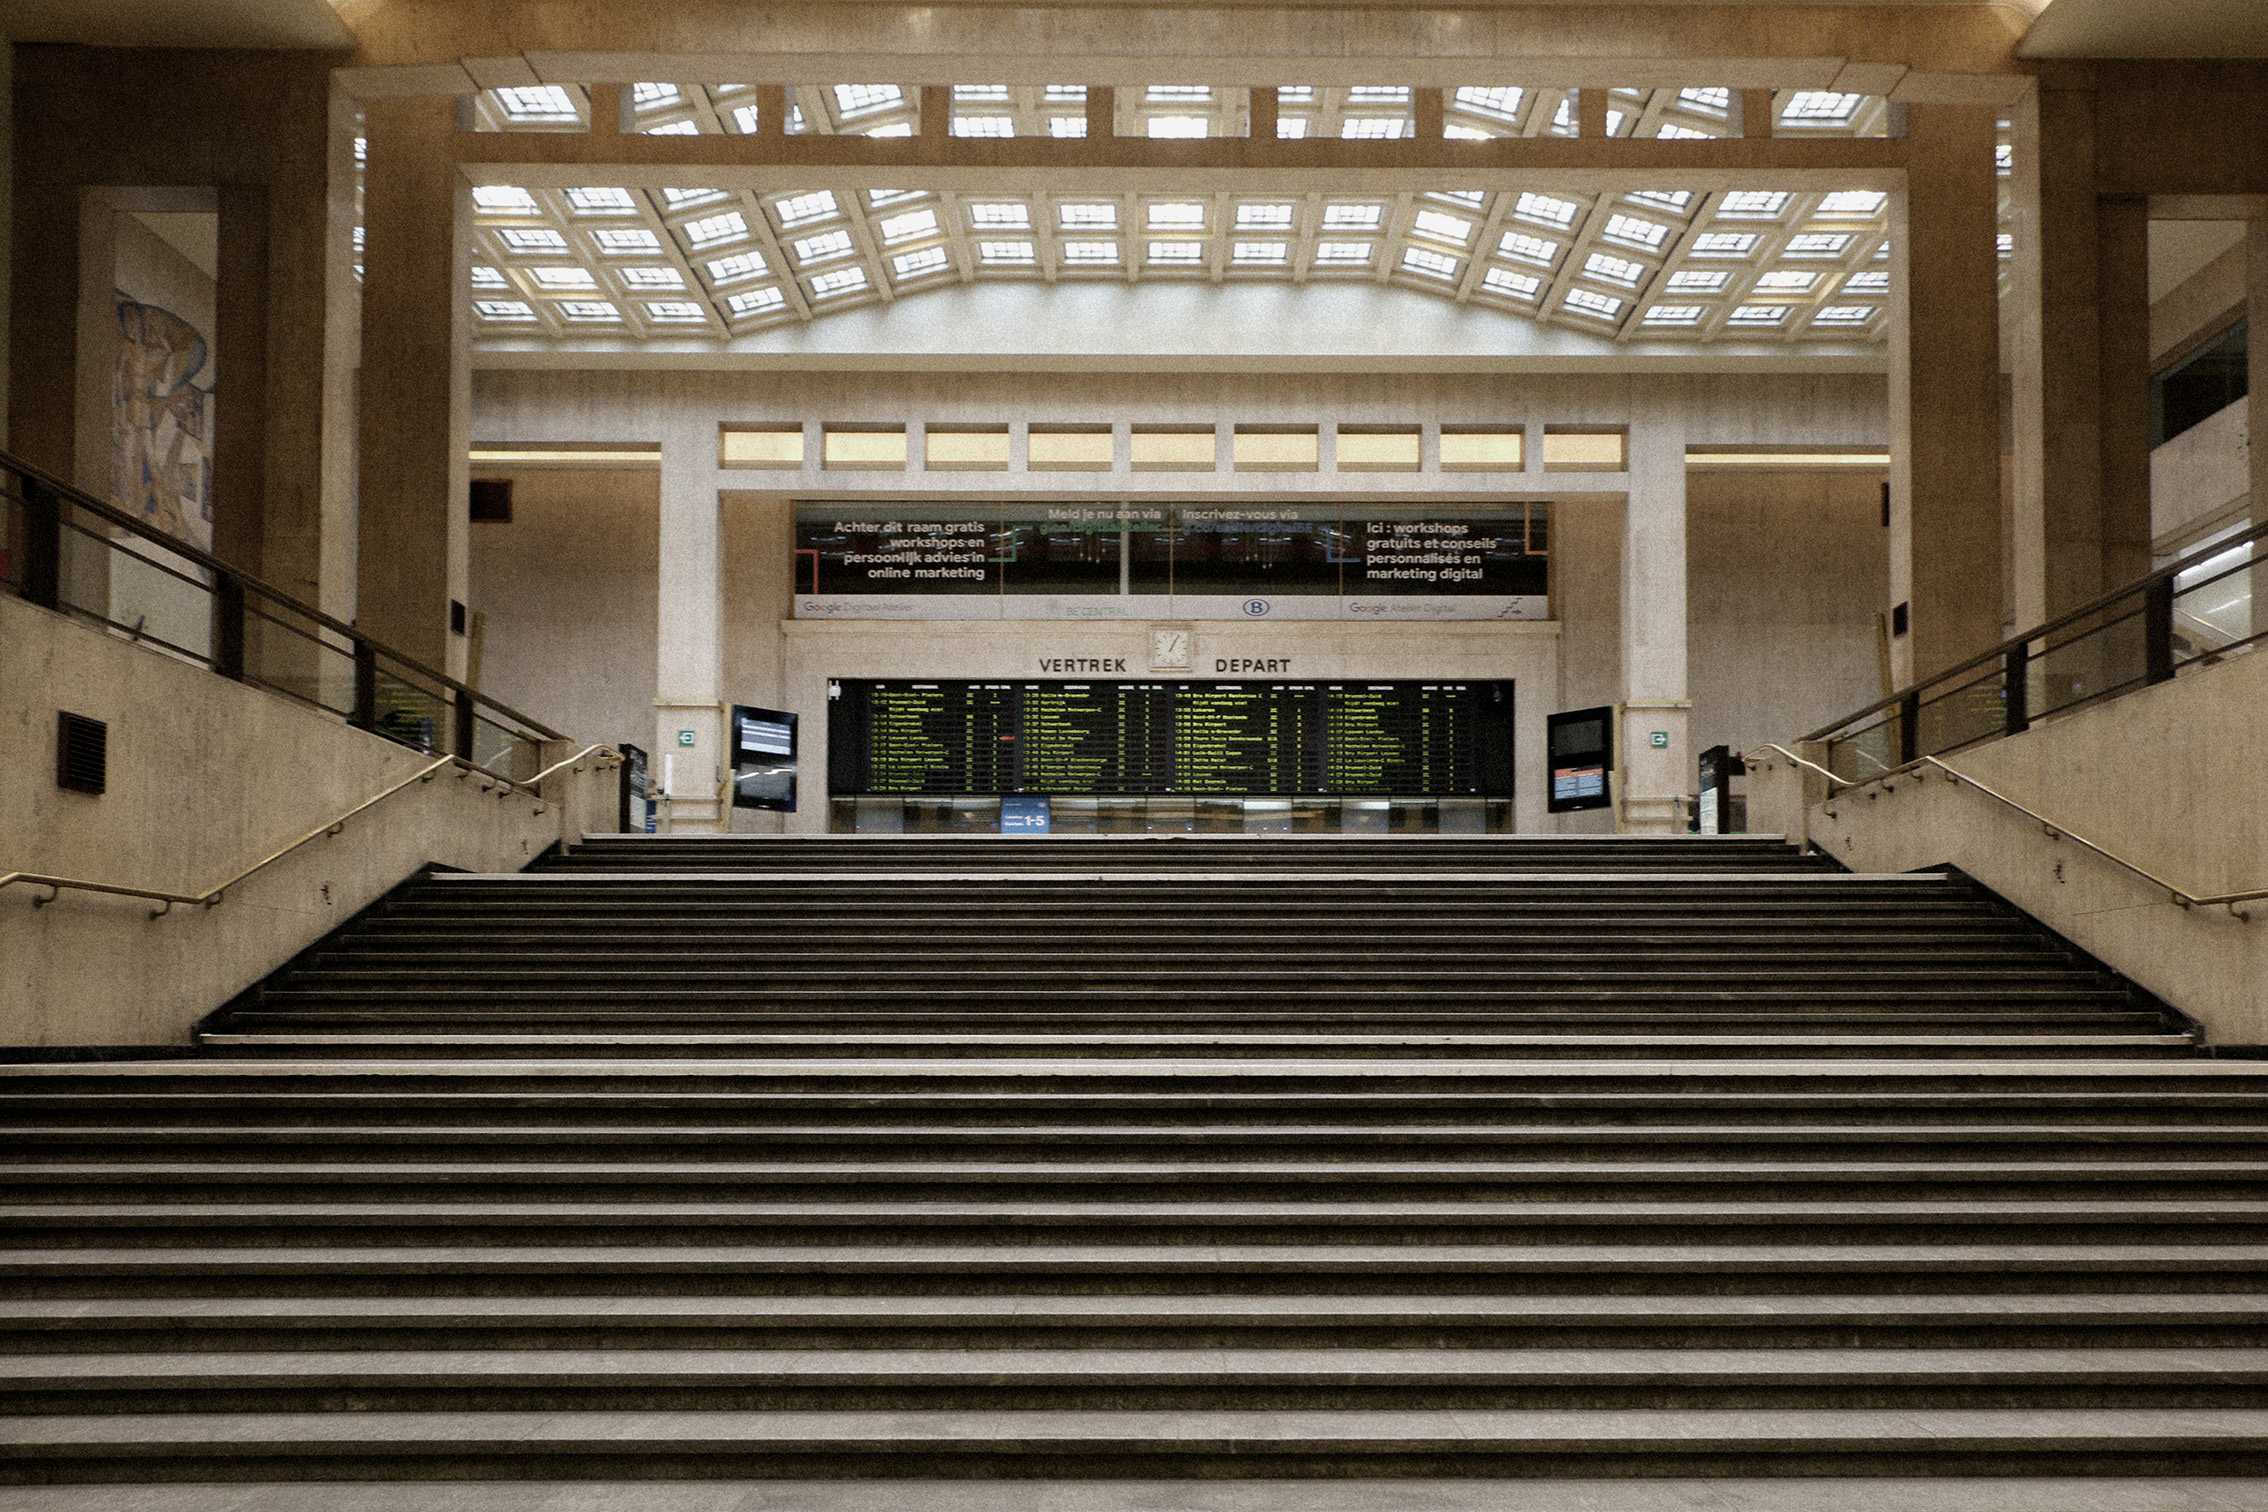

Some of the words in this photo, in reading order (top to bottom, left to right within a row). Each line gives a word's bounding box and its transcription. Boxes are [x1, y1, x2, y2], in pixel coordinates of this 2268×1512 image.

[1082, 508, 1094, 521] je
[1096, 510, 1113, 519] nu
[1116, 510, 1140, 519] aan
[1141, 508, 1162, 519] via
[1182, 509, 1277, 520] Inscrivez-vous
[1279, 509, 1298, 520] via
[834, 521, 881, 533] Achter
[883, 521, 902, 533] dit
[907, 523, 942, 533] raam
[945, 522, 985, 536] gratis
[1394, 522, 1468, 536] workshops
[891, 537, 964, 549] workshops
[967, 538, 985, 548] en
[1366, 538, 1421, 551] gratuits
[1423, 538, 1439, 549] et
[1442, 538, 1496, 549] conseils
[844, 552, 922, 565] persoonlijk
[924, 552, 969, 563] advies
[971, 552, 985, 563] in
[1367, 552, 1461, 566] personnalisés
[1464, 555, 1481, 564] en
[868, 567, 911, 578] online
[915, 567, 985, 580] marketing
[1367, 568, 1437, 581] marketing
[1439, 568, 1483, 581] digital
[804, 601, 842, 613] Google
[1350, 602, 1387, 615] Google
[1039, 658, 1127, 672] VERTREK
[1216, 659, 1291, 672] DEPART
[1024, 816, 1045, 826] 1-5
